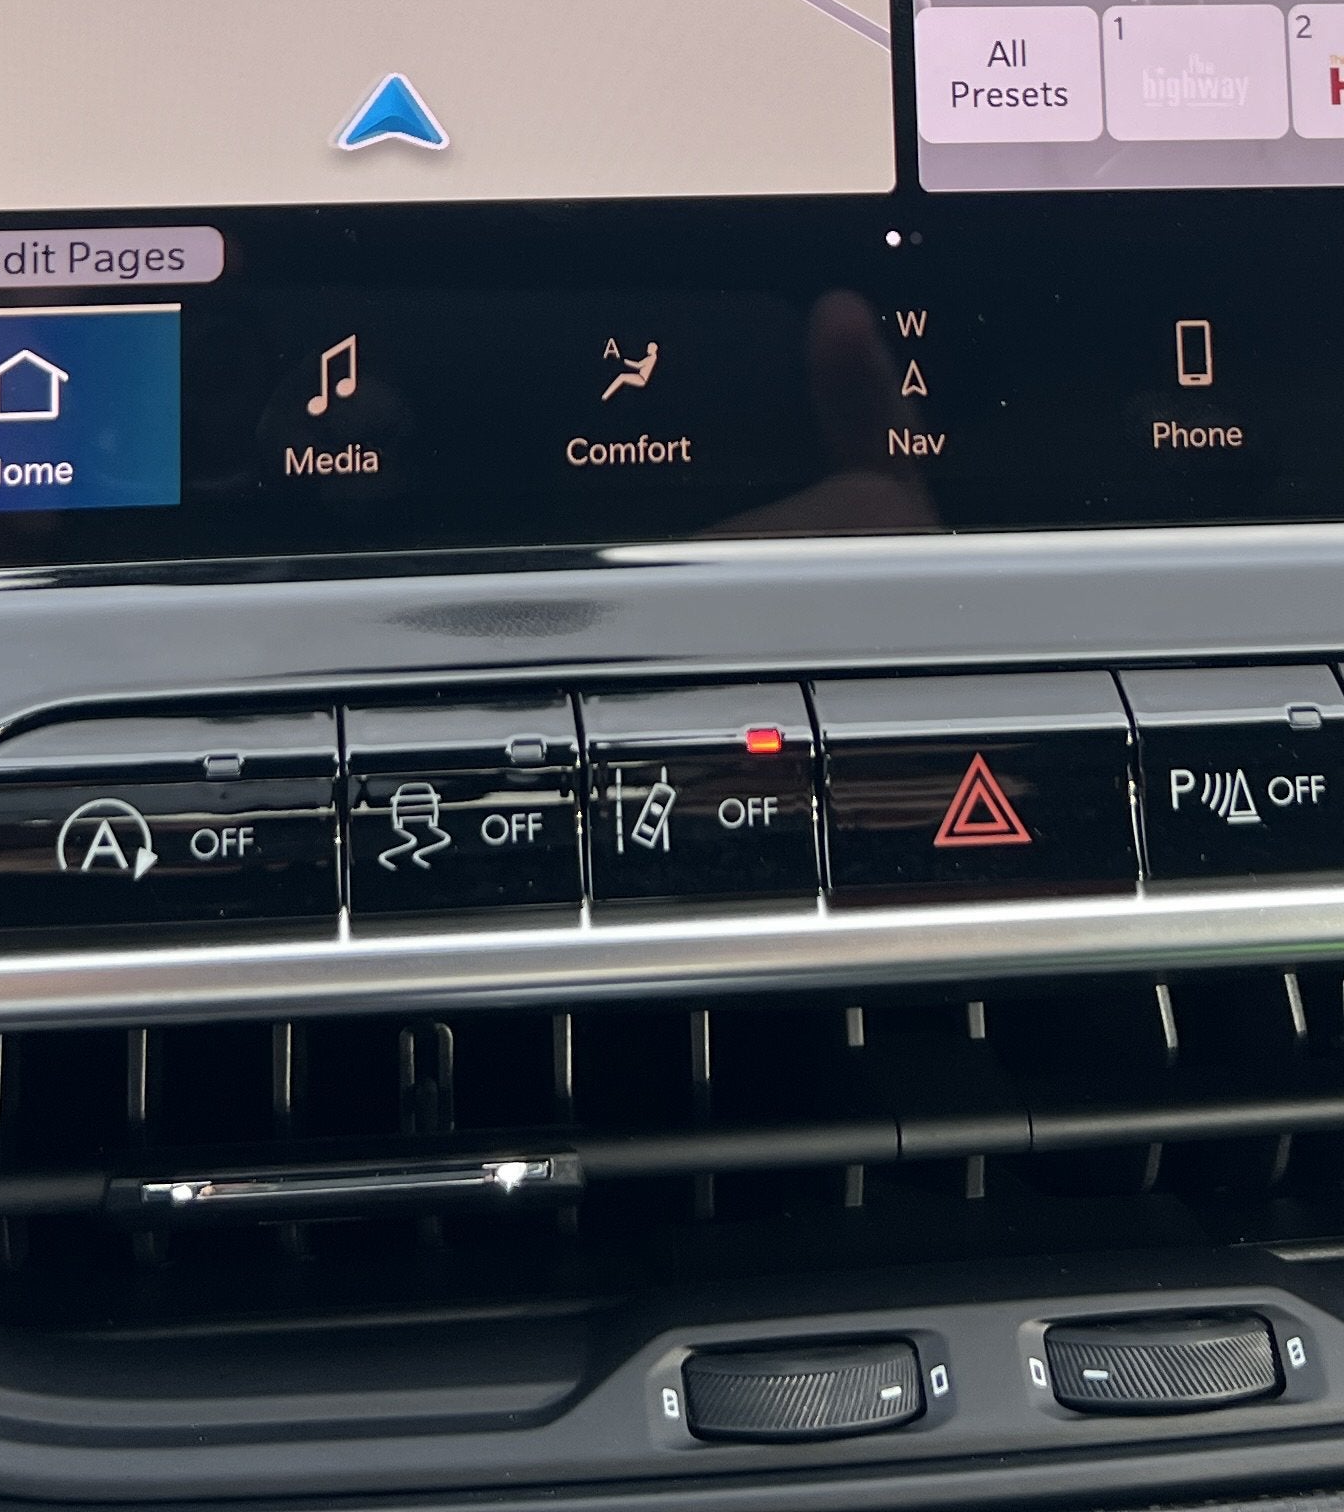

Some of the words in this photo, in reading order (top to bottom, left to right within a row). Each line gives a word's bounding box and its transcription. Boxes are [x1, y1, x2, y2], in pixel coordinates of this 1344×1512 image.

[1114, 16, 1123, 40] 1
[1296, 15, 1312, 39] 2
[987, 39, 1026, 67] All
[951, 81, 1069, 108] Presets
[1142, 67, 1249, 107] highway
[69, 241, 186, 279] Pages
[895, 310, 927, 338] W
[602, 337, 620, 359] A
[887, 428, 946, 456] Nav
[1152, 420, 1243, 448] Phone
[285, 443, 379, 476] Media
[566, 434, 692, 466] Comfort
[1170, 769, 1195, 810] P
[1268, 773, 1325, 805] OFF
[718, 797, 778, 829] OFF
[190, 827, 255, 860] OFF
[481, 812, 542, 846] OFF
